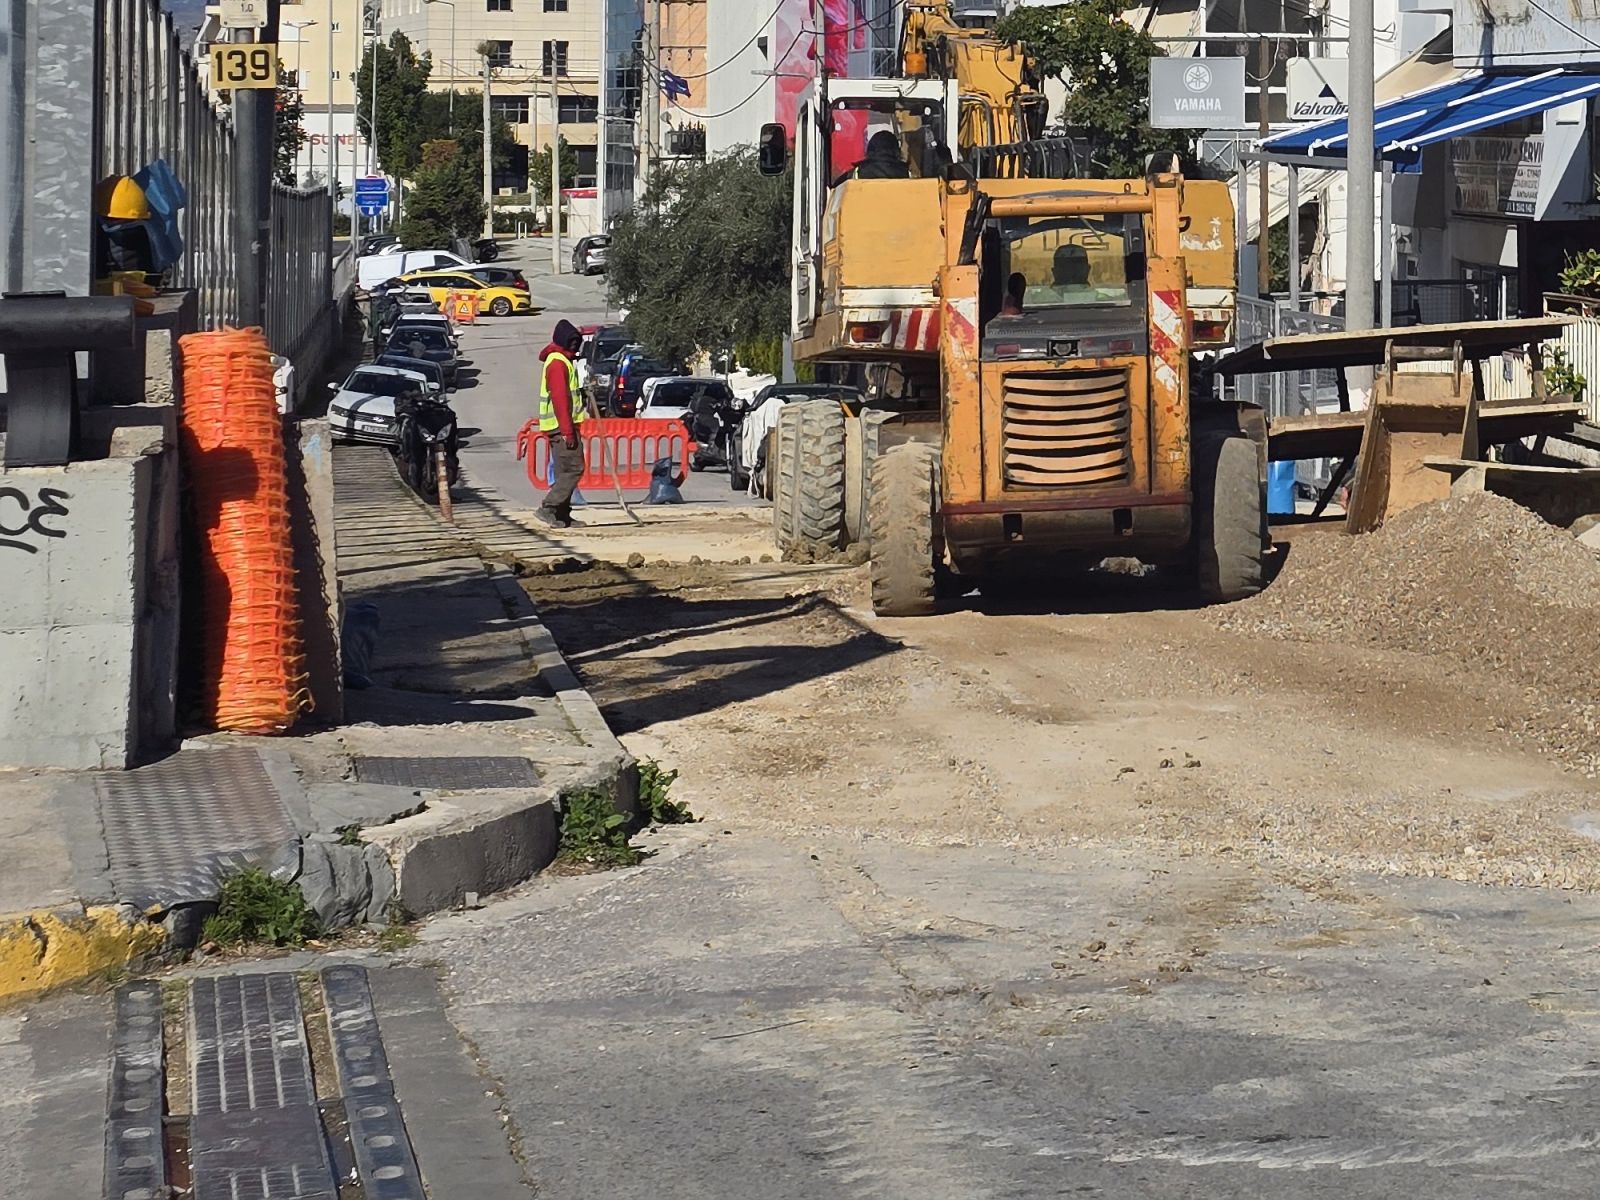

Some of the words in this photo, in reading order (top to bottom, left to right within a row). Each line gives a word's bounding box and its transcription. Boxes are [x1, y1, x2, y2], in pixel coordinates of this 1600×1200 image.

[215, 49, 270, 82] 139
[1174, 98, 1222, 112] YAMAHA
[1293, 101, 1349, 116] Valvolin
